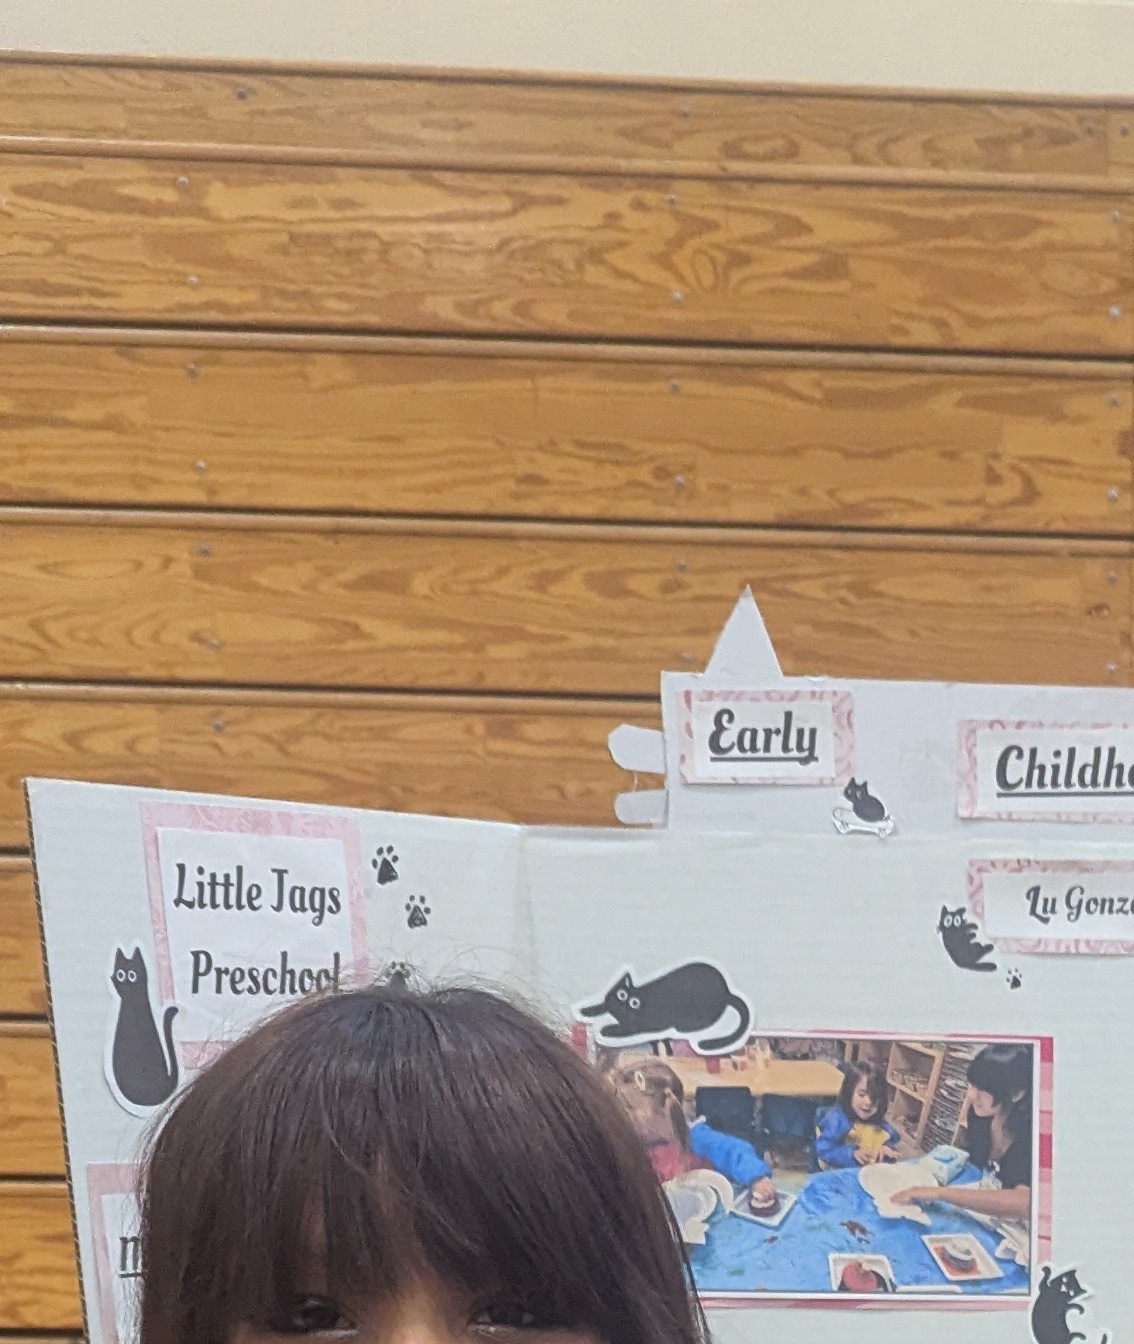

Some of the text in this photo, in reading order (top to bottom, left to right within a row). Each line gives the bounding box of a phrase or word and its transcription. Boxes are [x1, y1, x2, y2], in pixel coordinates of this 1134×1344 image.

[708, 707, 819, 765] Early
[173, 864, 342, 926] Little Jags
[1025, 886, 1057, 918] Lu
[190, 949, 340, 998] Preschool
